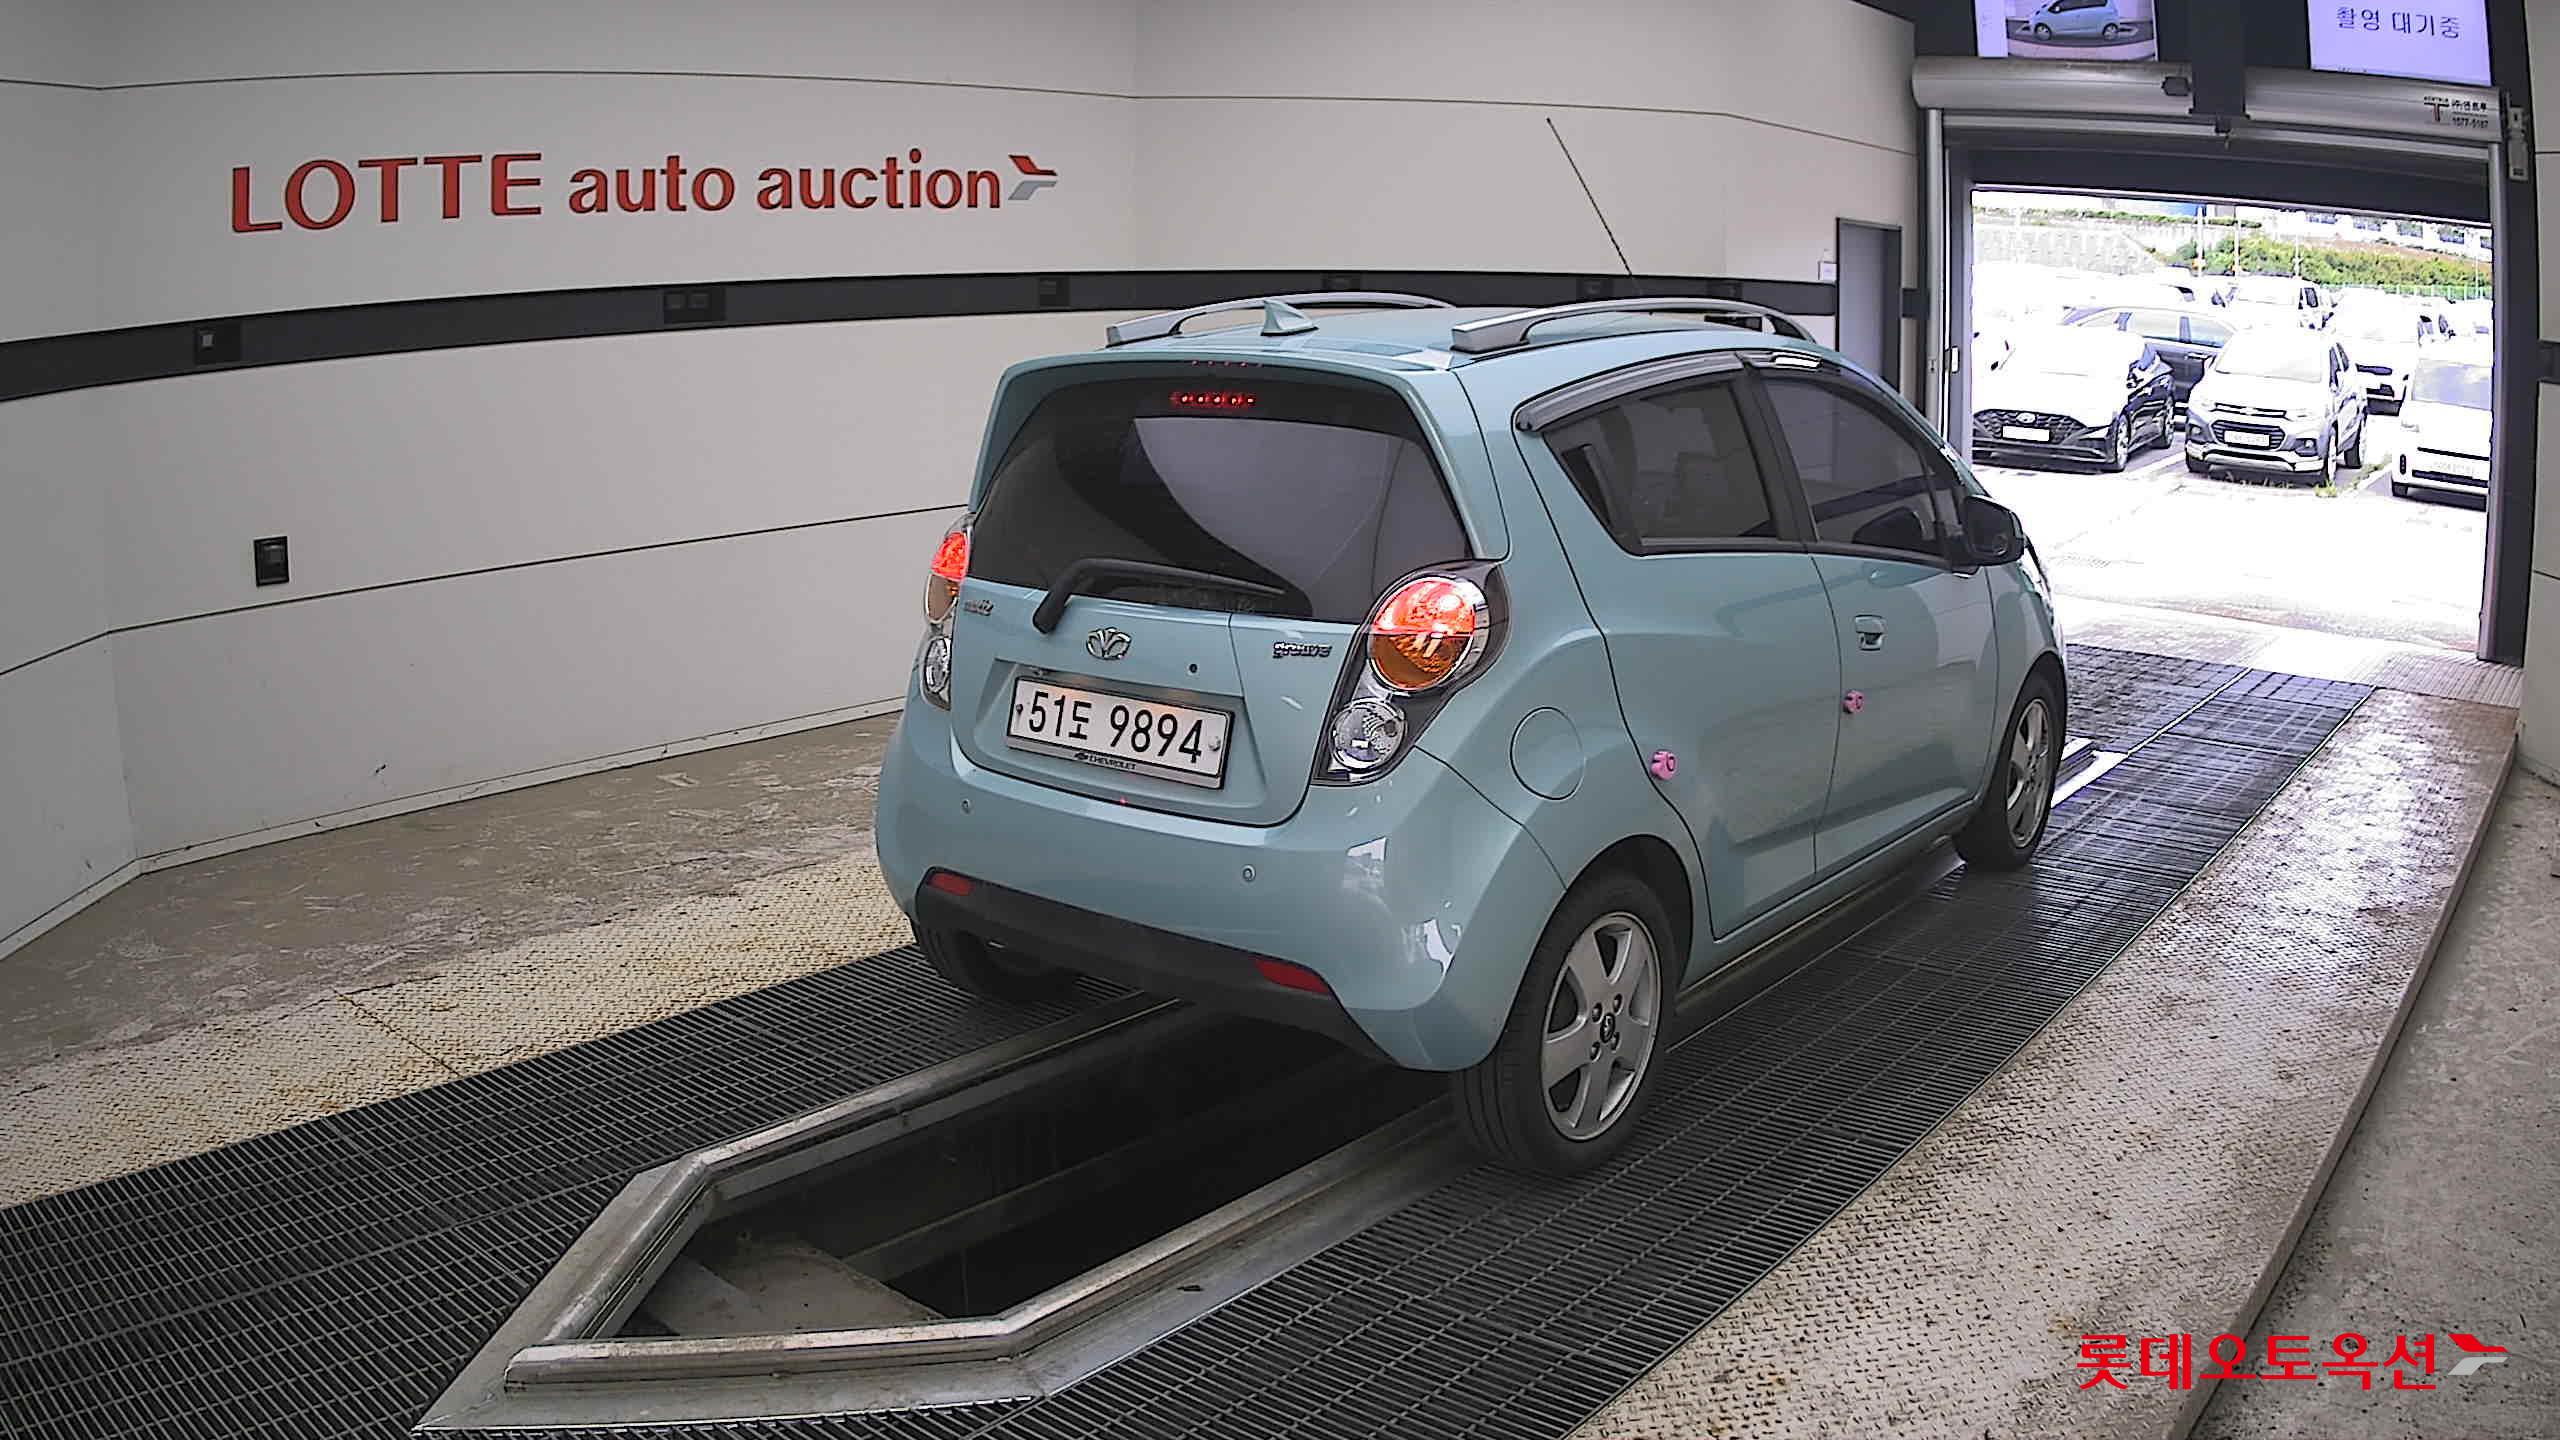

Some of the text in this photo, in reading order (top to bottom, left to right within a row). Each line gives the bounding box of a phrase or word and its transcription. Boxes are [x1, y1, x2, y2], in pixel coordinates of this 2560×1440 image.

[2337, 6, 2459, 39] 촬영 대기중
[232, 148, 1001, 233] LOTTE auto auction
[1028, 691, 1204, 764] 51도 9894
